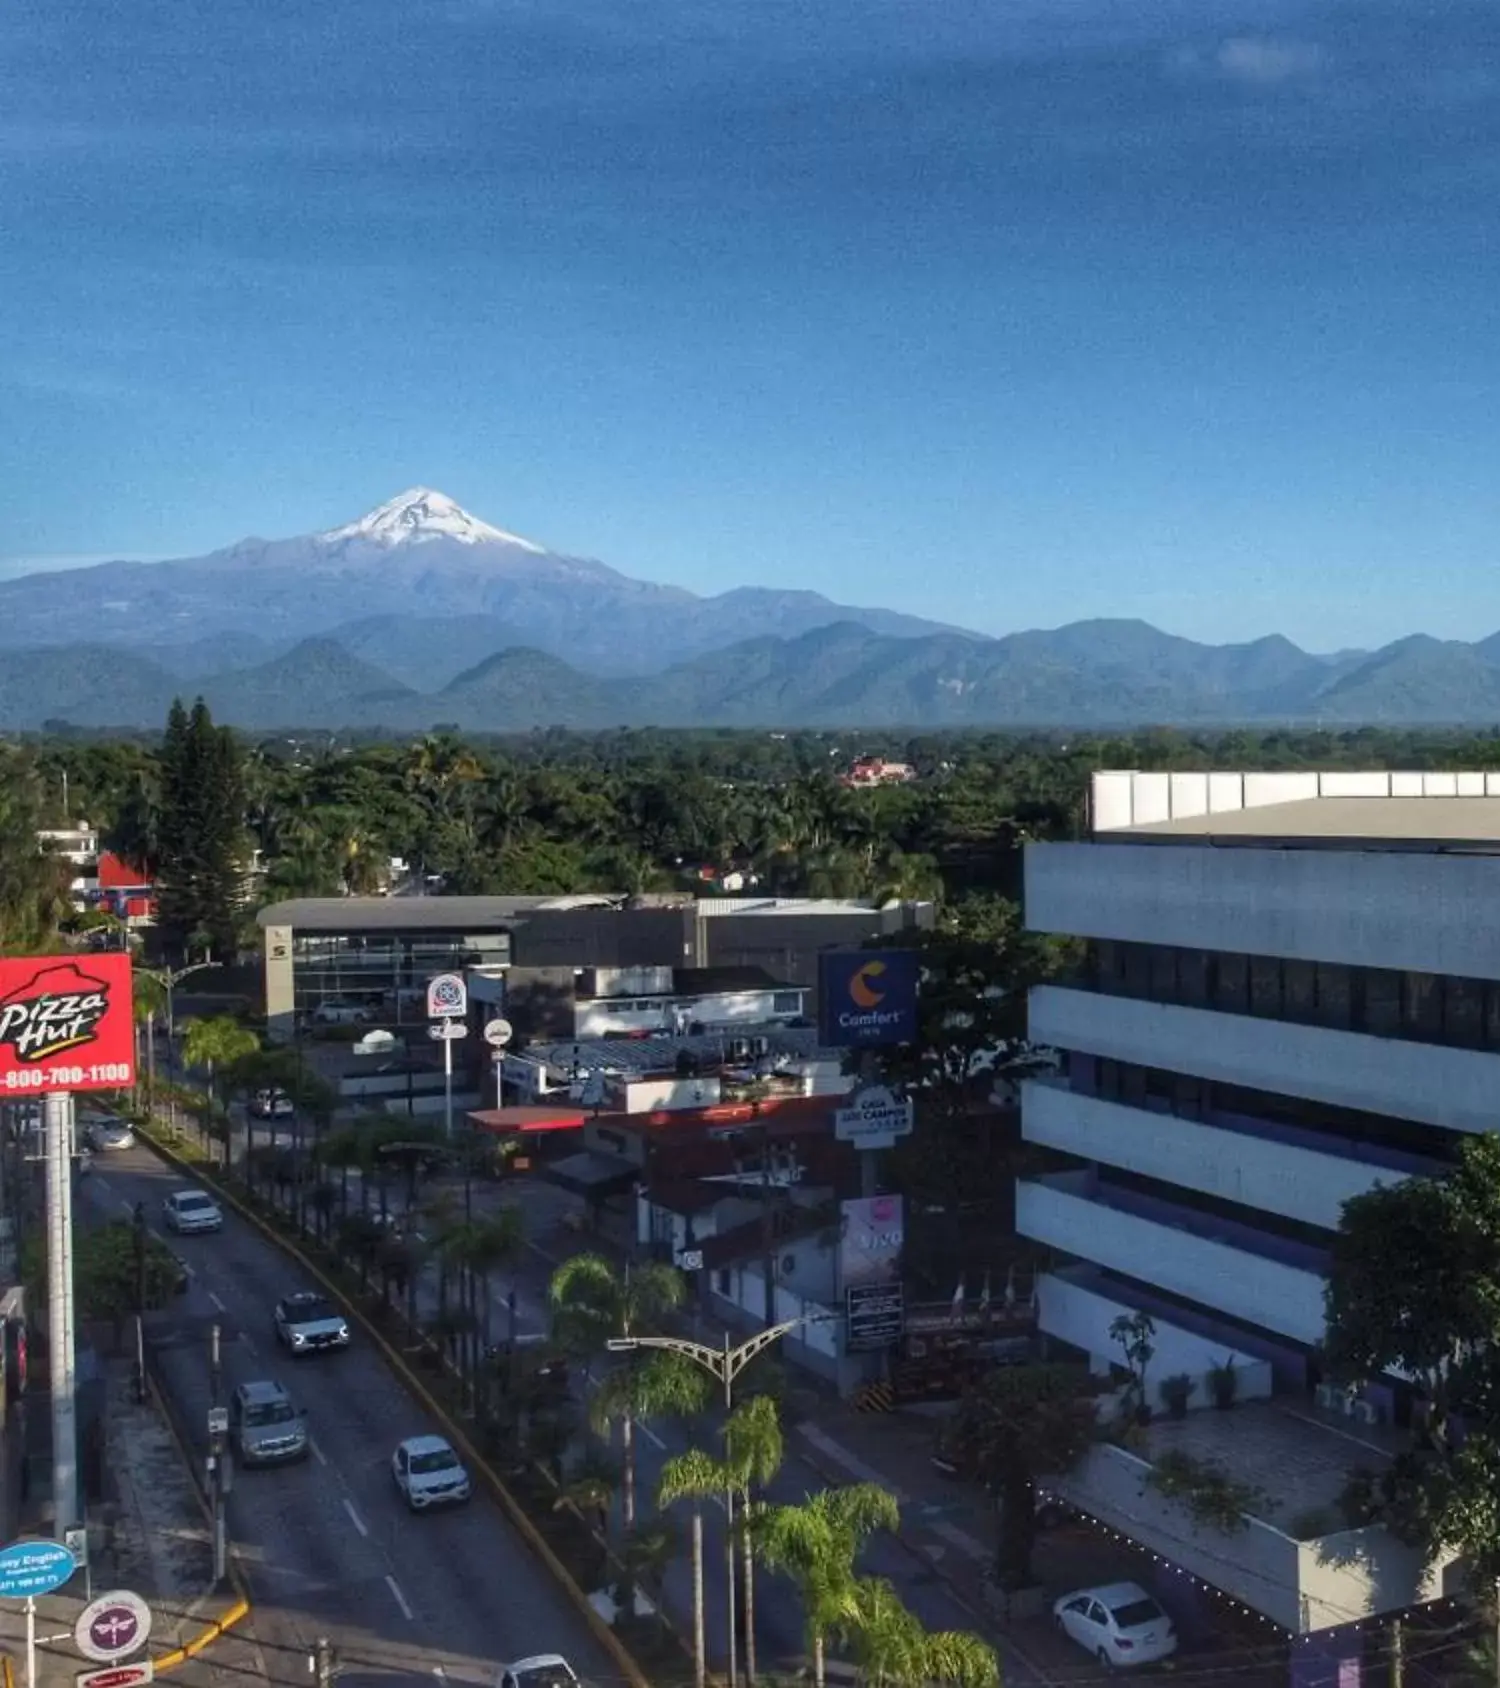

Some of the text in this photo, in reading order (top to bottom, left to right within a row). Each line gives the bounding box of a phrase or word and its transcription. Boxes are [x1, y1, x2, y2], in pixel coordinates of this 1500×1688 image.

[0, 992, 105, 1039] Pizza
[15, 1012, 95, 1054] Hut
[839, 1010, 901, 1027] Comfort
